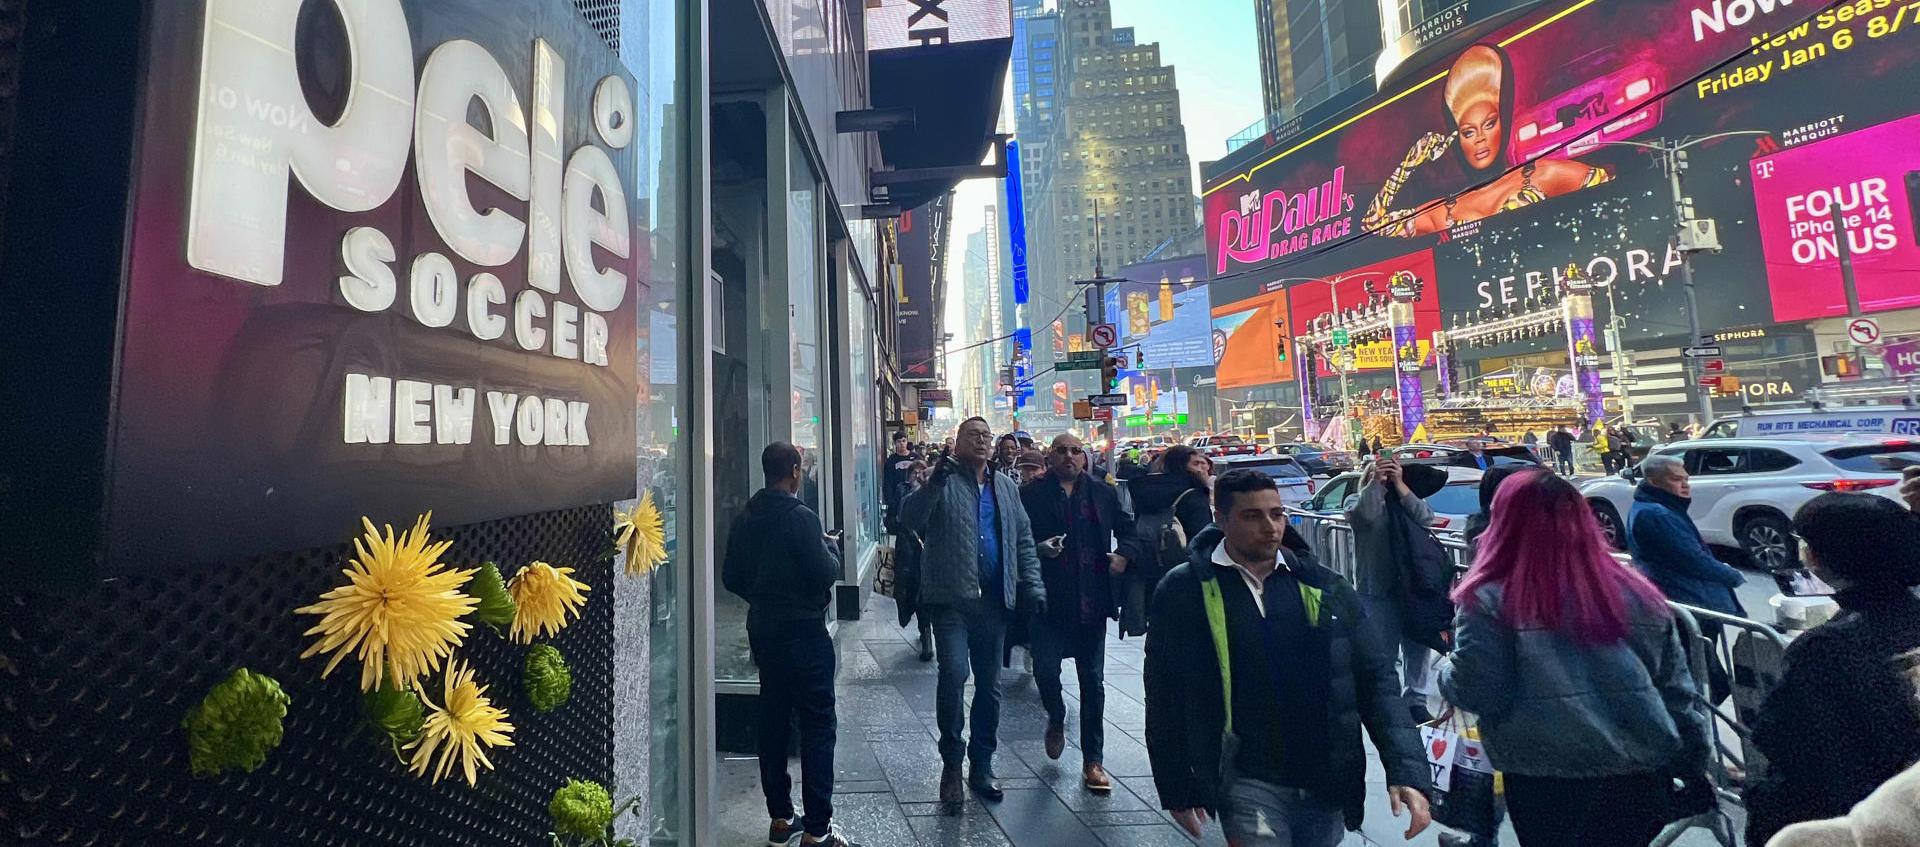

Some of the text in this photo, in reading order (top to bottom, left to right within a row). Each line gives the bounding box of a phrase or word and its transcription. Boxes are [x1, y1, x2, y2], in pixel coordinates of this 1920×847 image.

[1413, 3, 1469, 37] MARRIOTT
[1415, 17, 1463, 46] MARQUIS
[1750, 22, 1810, 55] New
[1696, 60, 1773, 99] Friday
[1780, 41, 1826, 70] Jan
[1831, 28, 1853, 50] 6
[1782, 115, 1845, 138] MARRIOTT
[1784, 127, 1839, 147] MARQUIS
[1785, 177, 1889, 222] FOUR
[1865, 204, 1893, 224] 14
[1217, 166, 1356, 275] RuPaul's
[1451, 220, 1482, 233] MARRIOTT
[1452, 228, 1480, 240] MARQUIS
[1270, 216, 1352, 260] DRAG RACE
[1791, 223, 1898, 264] ON US
[339, 226, 610, 367] SOCCER
[1714, 329, 1765, 342] SEPHORA
[1358, 347, 1394, 356] NEW YEA
[343, 373, 590, 447] NEW YORK
[1756, 422, 1772, 431] RUN
[1775, 421, 1794, 430] RITE
[1797, 419, 1853, 430] MECHANICAL
